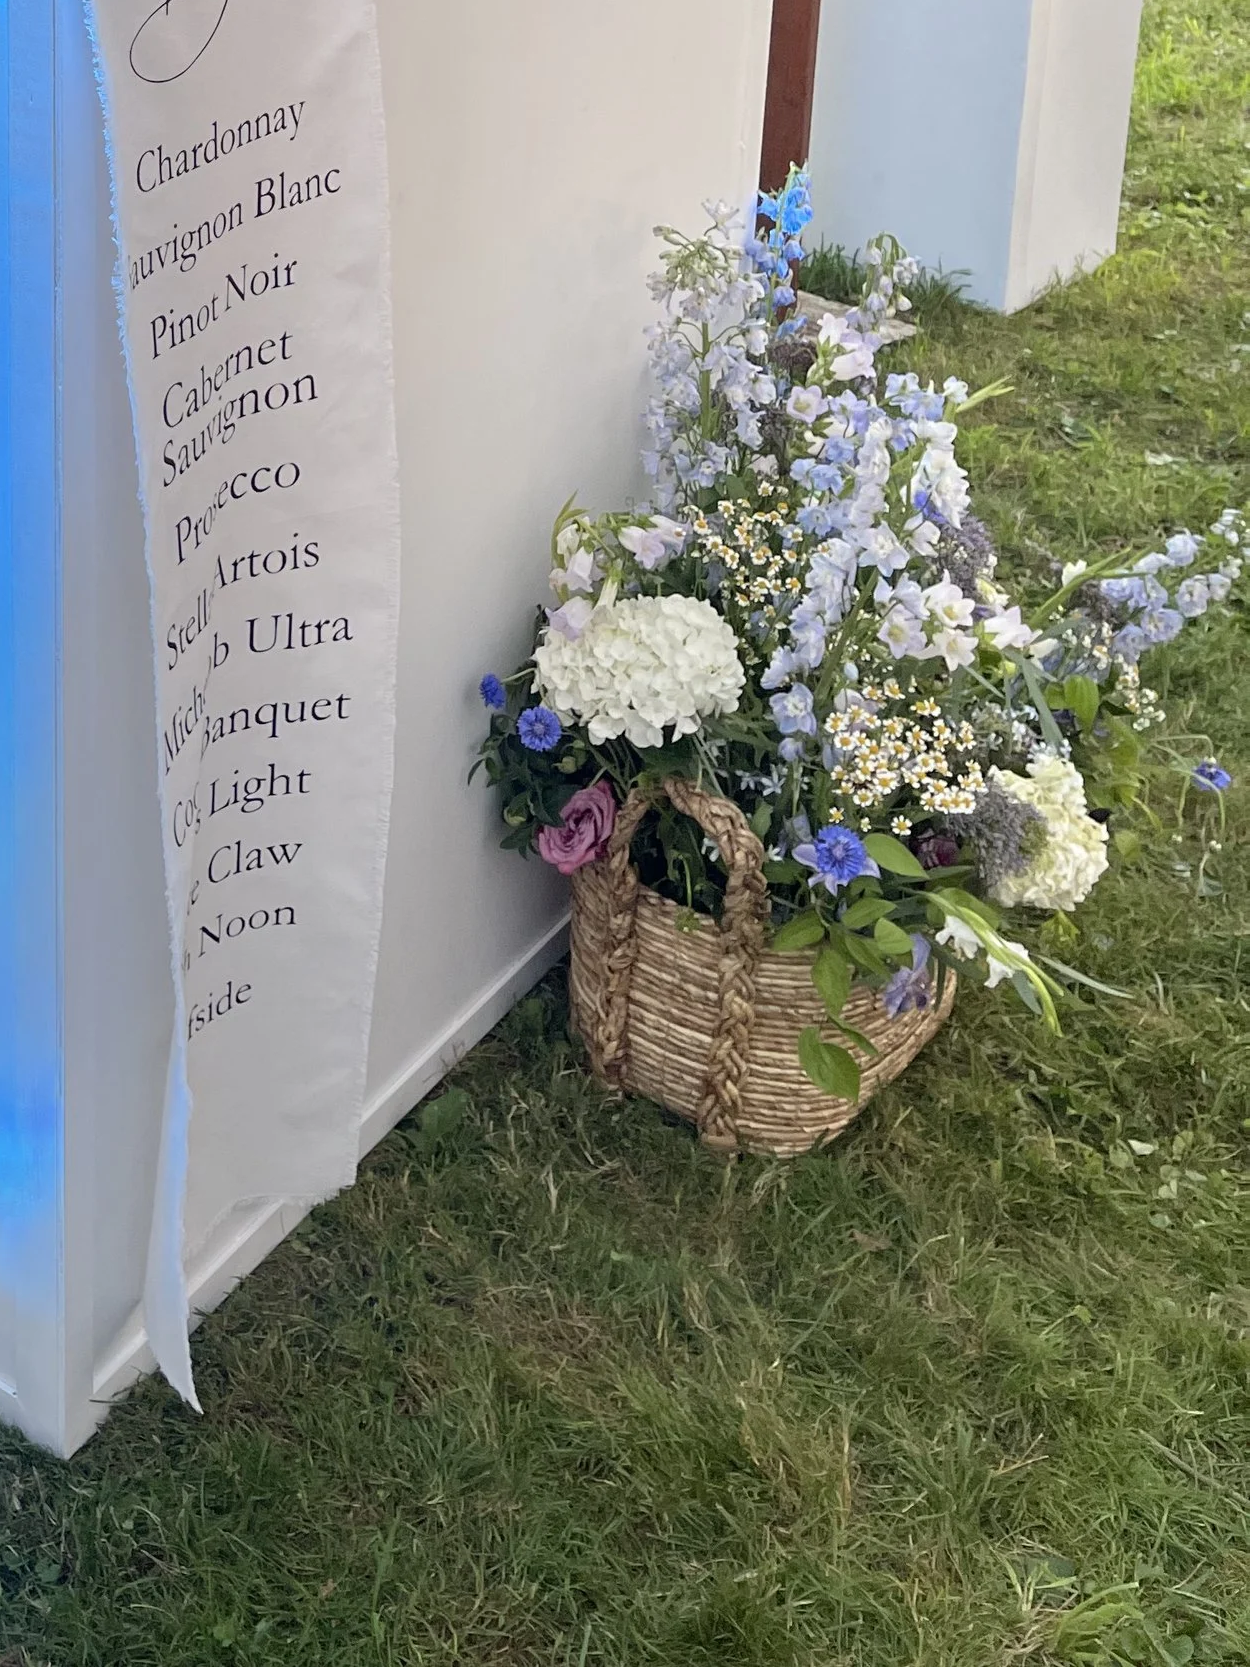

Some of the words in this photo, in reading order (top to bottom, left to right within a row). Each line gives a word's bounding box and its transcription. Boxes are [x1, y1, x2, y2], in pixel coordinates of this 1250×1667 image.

[136, 100, 306, 194] Chardonnay
[128, 202, 243, 291] auvignon
[254, 166, 342, 219] Blanc
[150, 292, 219, 360] Pinot
[224, 252, 298, 312] Noir
[162, 330, 293, 428] Cabernet
[162, 373, 318, 487] Sauvignon
[213, 533, 321, 590] Artois
[245, 612, 353, 653] Ultra
[209, 763, 312, 818] Light
[208, 840, 303, 884] Claw
[198, 905, 297, 959] Noon
[187, 981, 252, 1041] fside
